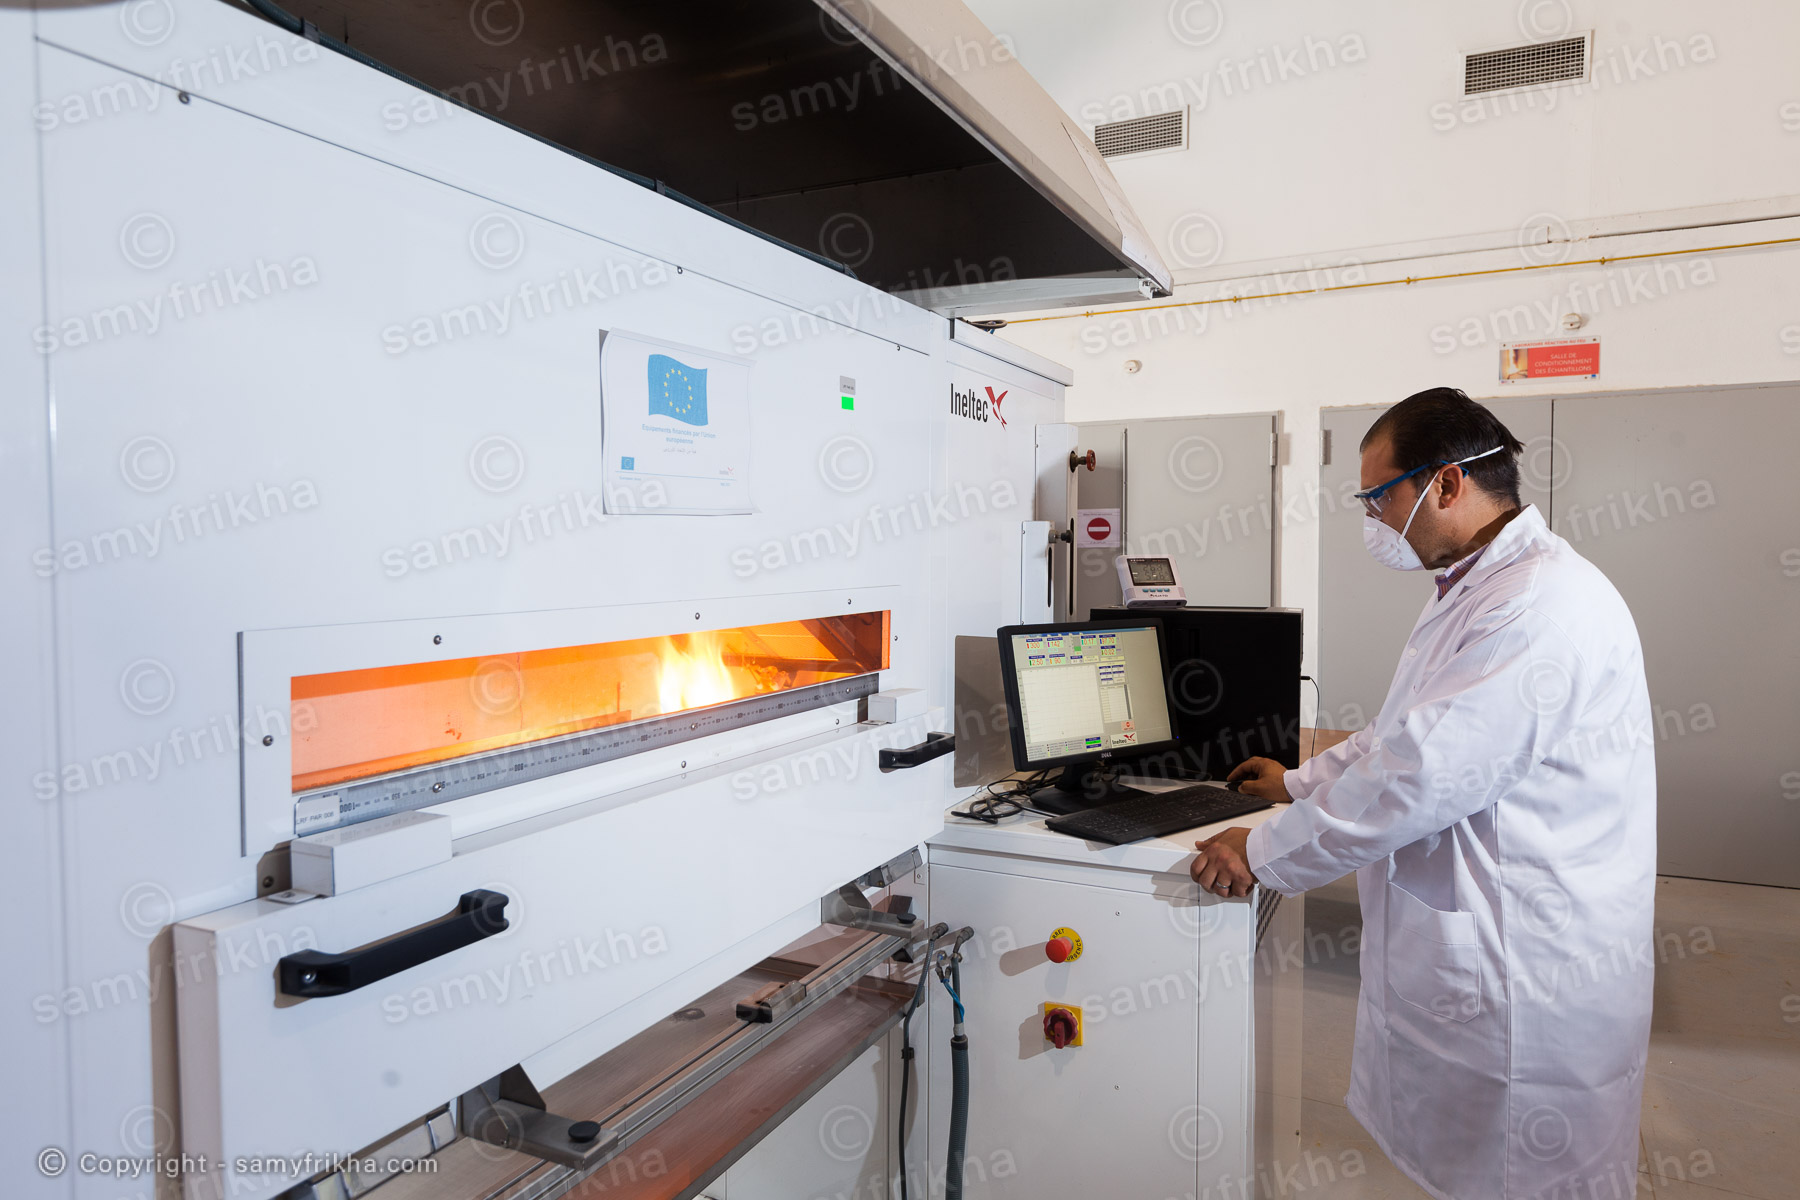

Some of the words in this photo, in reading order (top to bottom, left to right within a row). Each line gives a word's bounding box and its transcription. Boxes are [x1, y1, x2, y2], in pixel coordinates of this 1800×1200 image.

[1534, 358, 1592, 367] CONDITIONNEMENT
[1547, 365, 1592, 374] ÉCHANTILLONS
[950, 382, 989, 423] Ineltec
